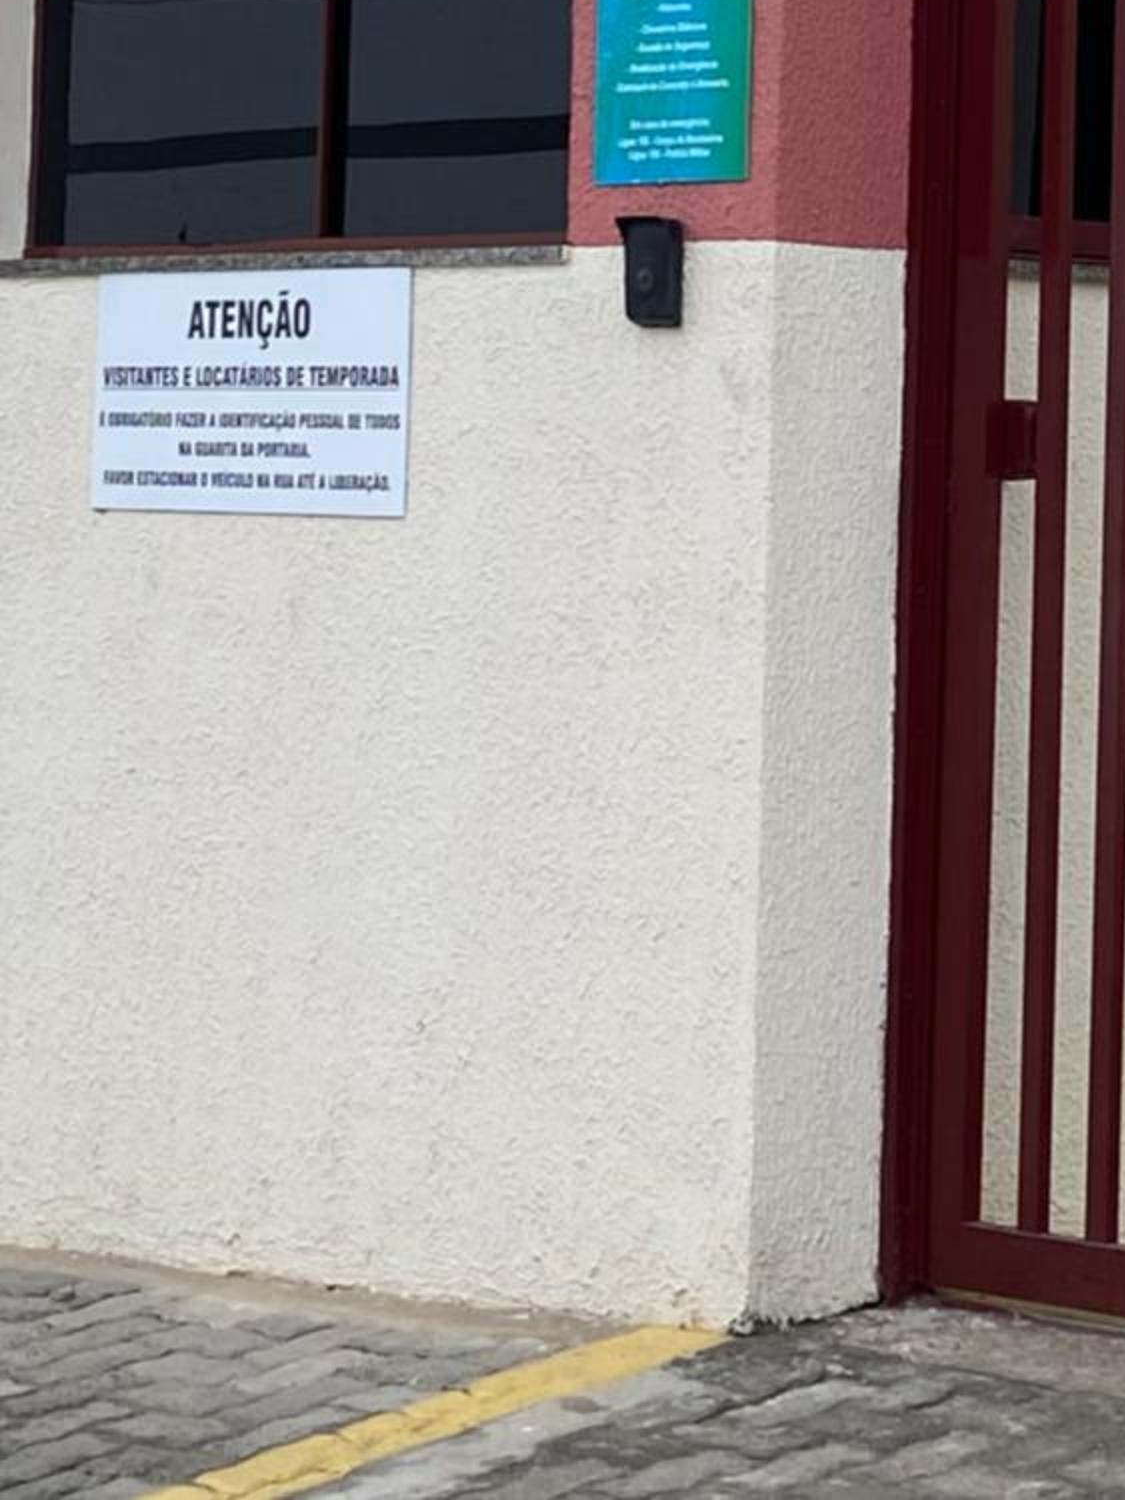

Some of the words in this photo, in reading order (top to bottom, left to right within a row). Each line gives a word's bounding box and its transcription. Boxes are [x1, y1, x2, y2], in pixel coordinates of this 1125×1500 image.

[187, 289, 311, 350] ATENÇÃO
[103, 365, 179, 387] VISITANTES
[183, 366, 192, 386] E
[196, 361, 282, 387] LOCATÁRIOS
[286, 366, 304, 386] DE
[309, 366, 400, 387] TEMPORADA
[108, 409, 172, 428] OBRIGATÓRIO
[176, 412, 206, 427] FAZER
[209, 413, 216, 427] A
[219, 410, 296, 431] IDENTIFICAÇÃO
[300, 413, 344, 429] PESSOAL
[347, 414, 361, 429] DE
[365, 414, 400, 430] TODOS
[178, 441, 192, 456] NA
[195, 441, 237, 457] GUARITA
[241, 442, 254, 457] DA
[103, 470, 134, 485] FAVOR
[137, 470, 198, 487] ESTACIONAR
[201, 472, 209, 487] O
[257, 473, 271, 488] NA
[274, 473, 294, 488] RUA
[298, 472, 316, 490] ATÉ
[318, 475, 326, 490] A
